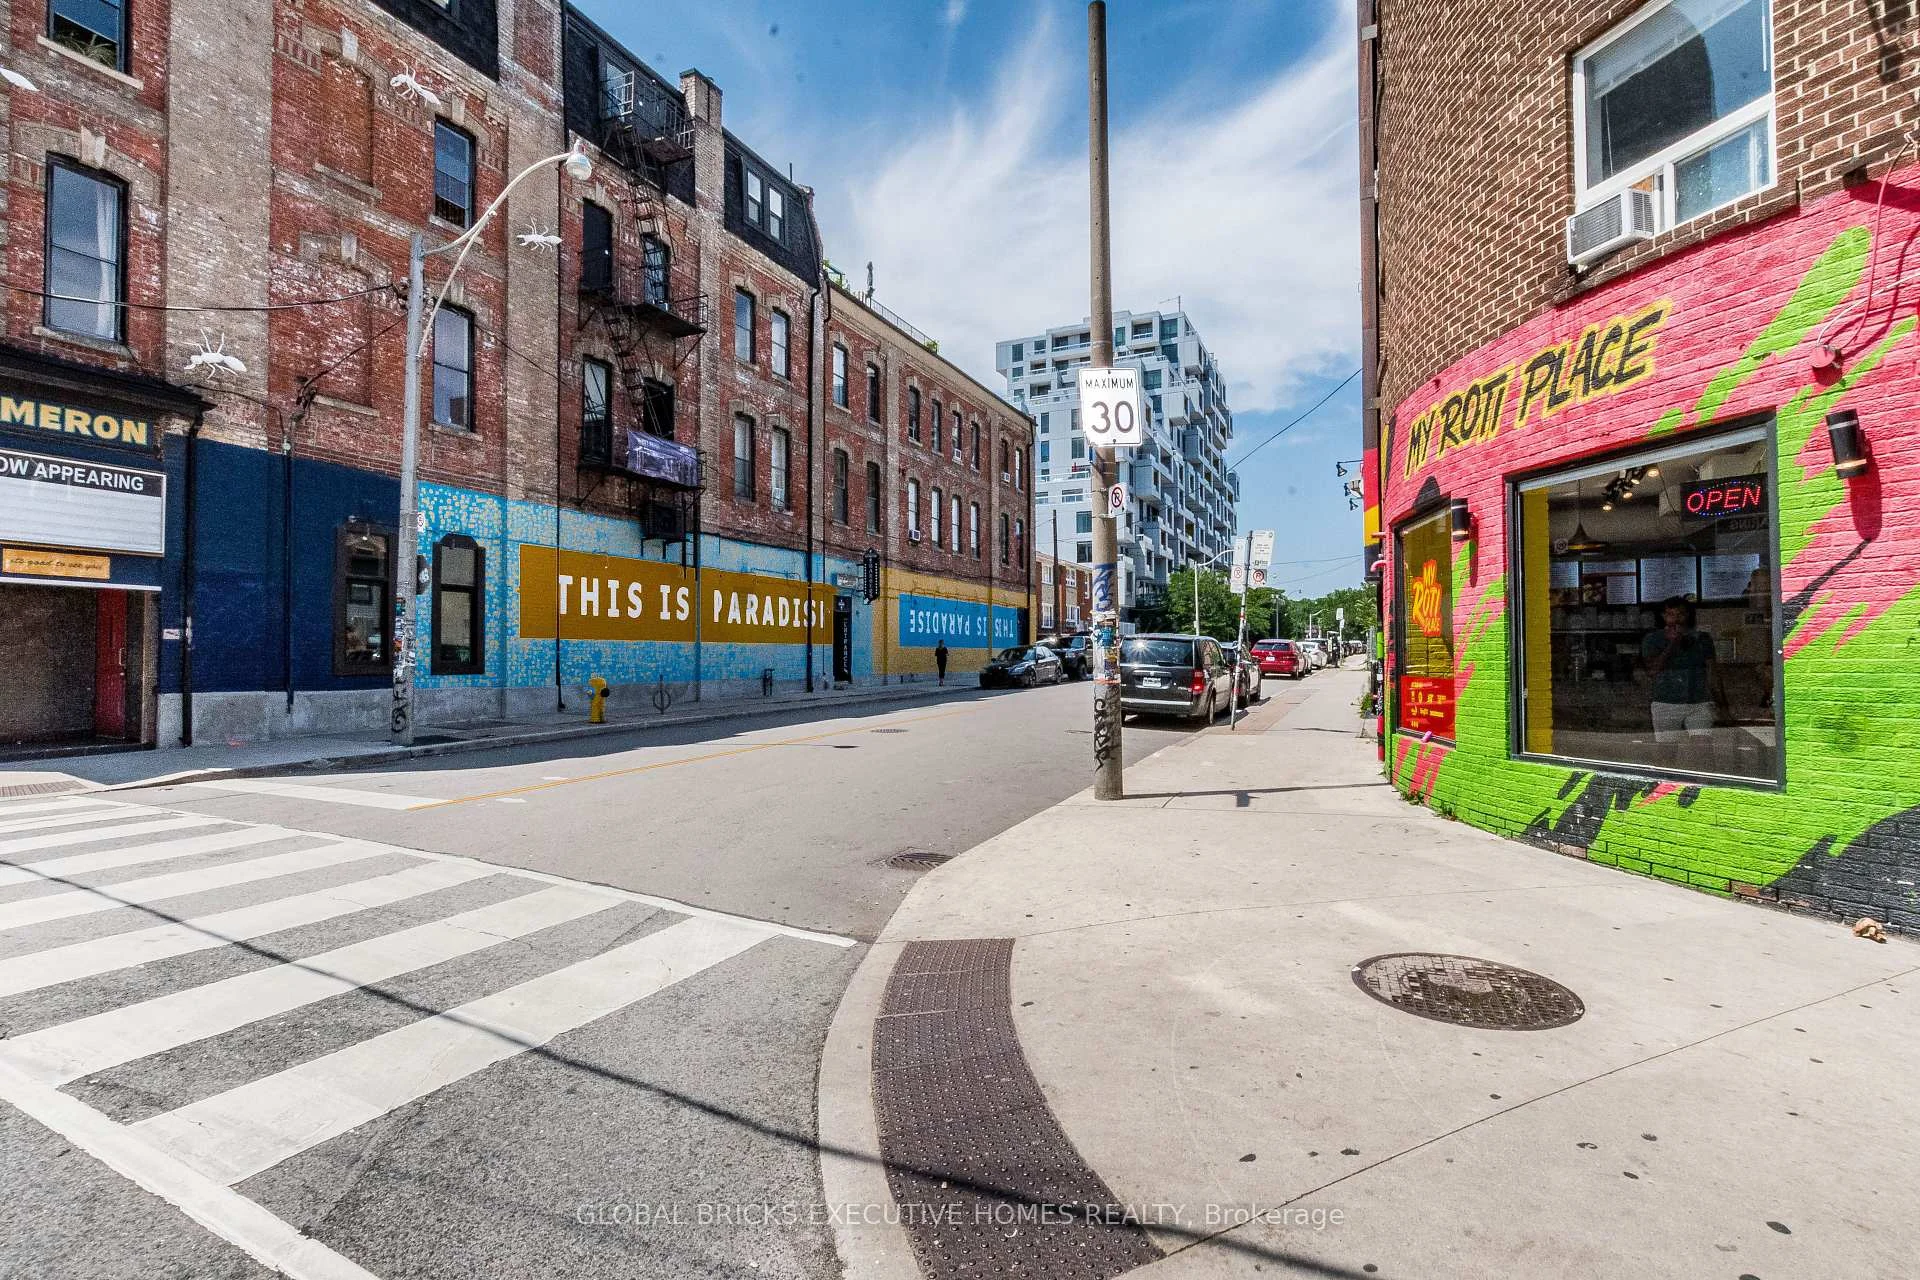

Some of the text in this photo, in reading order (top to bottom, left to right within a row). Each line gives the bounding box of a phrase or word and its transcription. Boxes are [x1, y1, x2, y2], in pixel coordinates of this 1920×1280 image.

[1085, 378, 1134, 389] MAXIMUM
[1405, 309, 1664, 477] MY ROTI PLACE
[1091, 400, 1134, 434] 30
[34, 462, 144, 491] APPEARING
[1687, 486, 1761, 513] OPEN
[558, 575, 643, 619] THIS
[659, 584, 690, 621] IS
[909, 609, 971, 636] PARADISE
